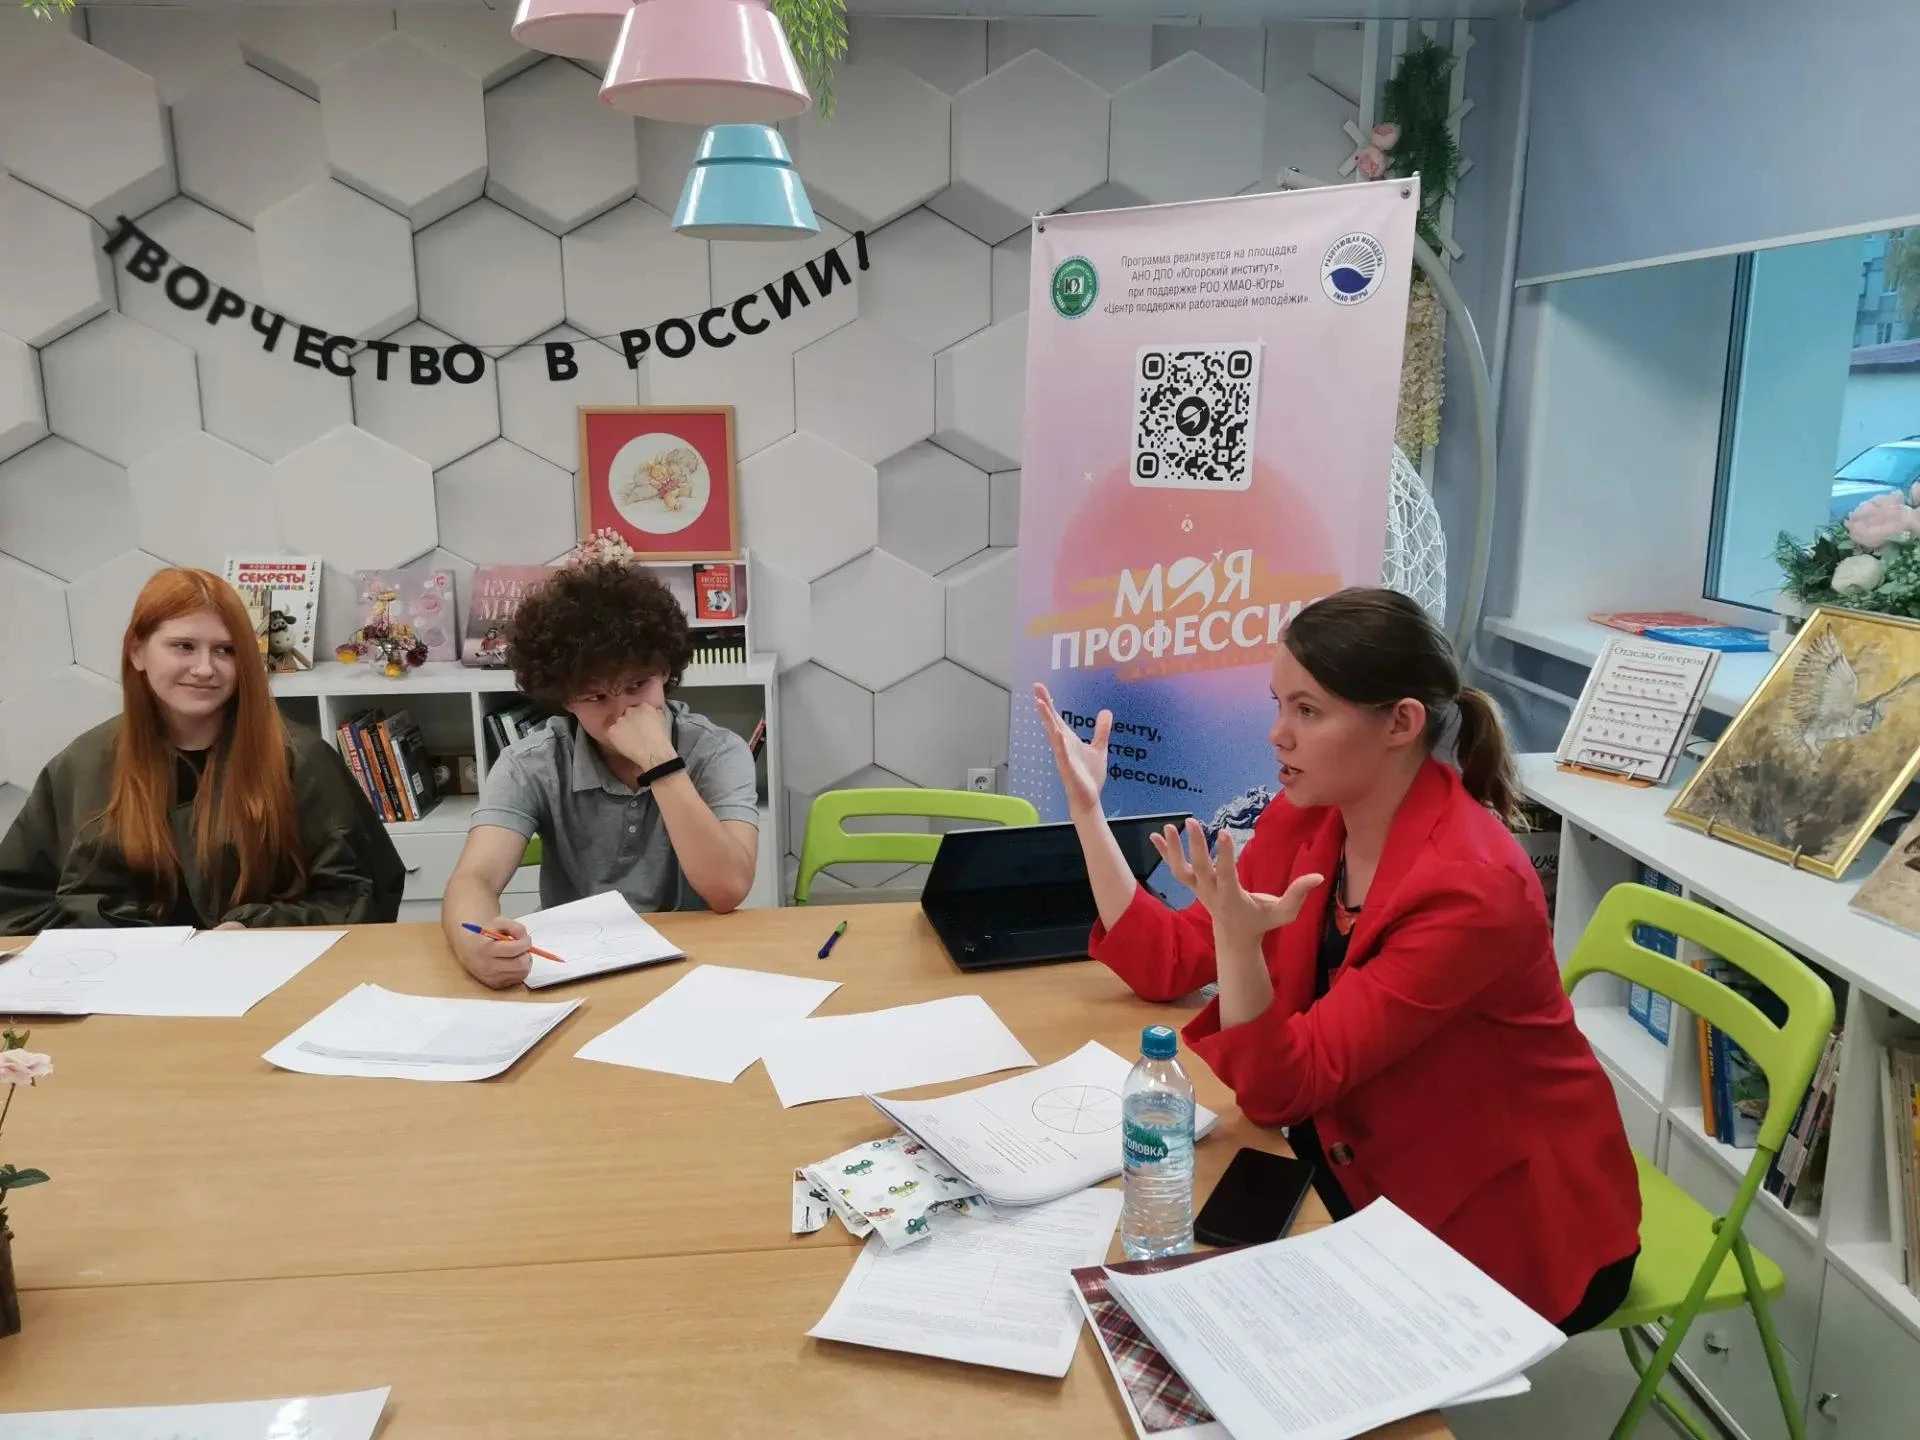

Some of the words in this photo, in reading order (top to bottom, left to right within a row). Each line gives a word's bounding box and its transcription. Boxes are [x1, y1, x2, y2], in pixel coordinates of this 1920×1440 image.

[1120, 255, 1171, 268] Программа
[1173, 250, 1231, 265] реализуется
[1234, 250, 1245, 259] на
[1248, 244, 1298, 258] площадке
[1132, 269, 1150, 282] АНО
[1153, 268, 1174, 282] ДПО
[1176, 265, 1228, 280] «Югорский
[1231, 262, 1282, 275] институт»,
[1128, 287, 1144, 298] при
[1146, 284, 1197, 297] поддержке
[1200, 281, 1220, 293] РОО
[1222, 278, 1285, 293] ХМАО-Югры
[103, 215, 486, 386] ТВОРЧЕСТВО
[545, 341, 579, 383] В
[620, 229, 871, 370] РОССИИ!
[1103, 303, 1134, 315] «Центр
[1136, 300, 1186, 313] поддержки
[1188, 295, 1248, 309] работающей
[238, 572, 306, 584] СЕКРЕТЫ
[1114, 549, 1253, 617] МОЯ
[1051, 596, 1327, 670] ПРОФЕССИ
[1614, 646, 1656, 660] Отделка
[1061, 710, 1096, 729] Про
[1110, 720, 1162, 742] ечту,
[1107, 763, 1203, 793] фессию...
